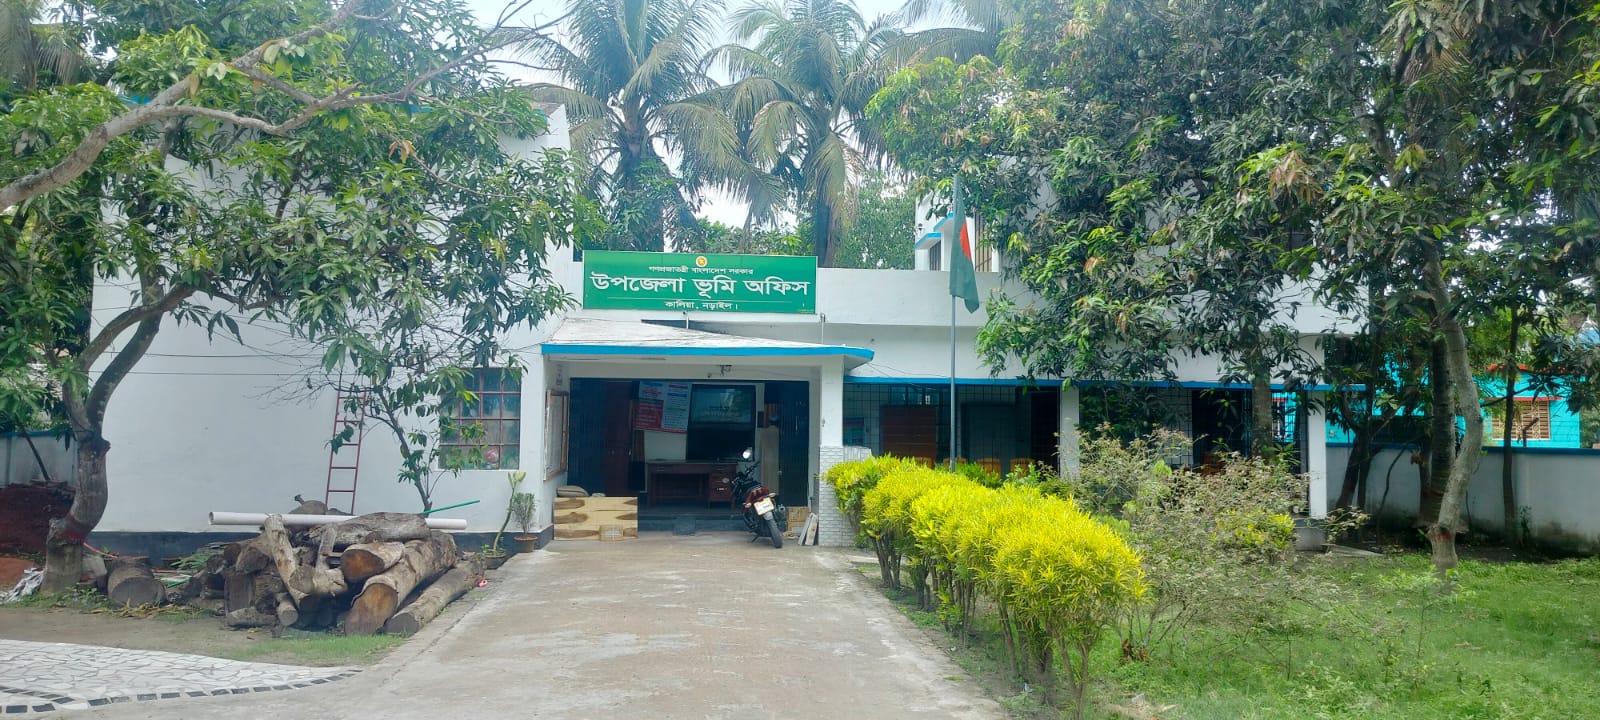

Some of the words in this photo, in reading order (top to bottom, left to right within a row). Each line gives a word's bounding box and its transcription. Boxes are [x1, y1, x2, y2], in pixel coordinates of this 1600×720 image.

[589, 271, 687, 293] উপজেলা
[692, 274, 737, 299] ভূমি
[743, 276, 811, 296] অফিস
